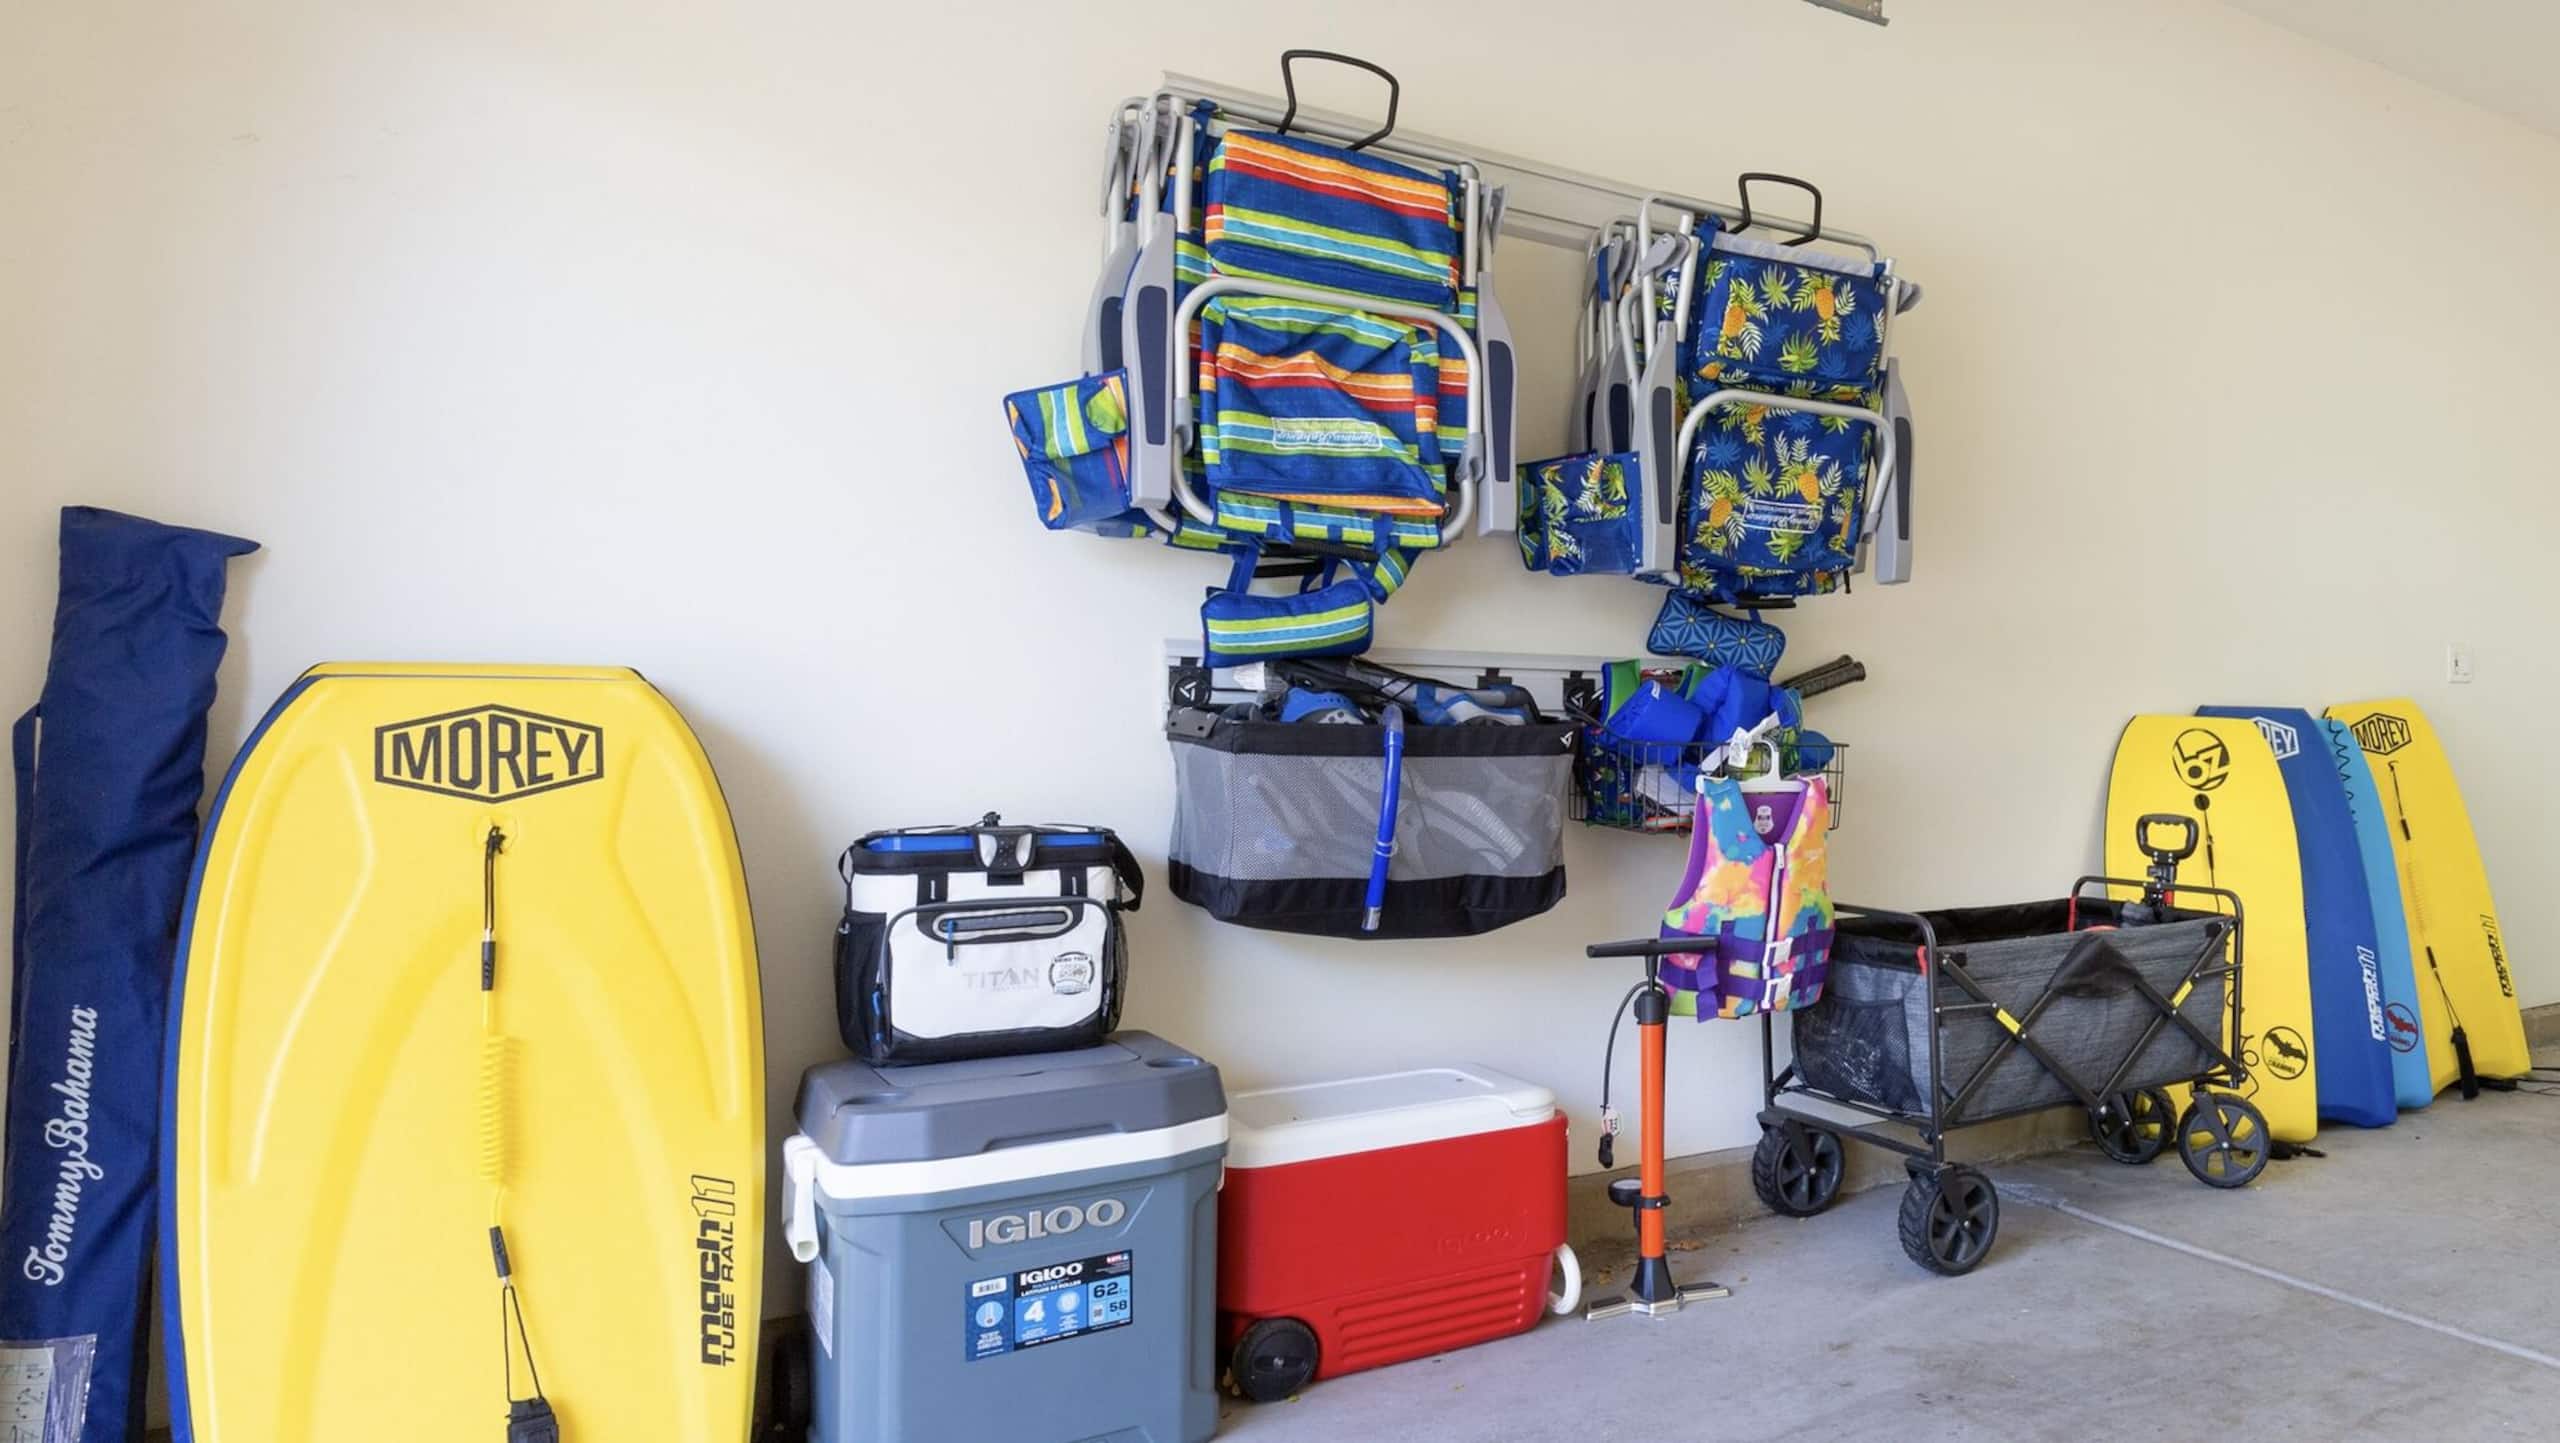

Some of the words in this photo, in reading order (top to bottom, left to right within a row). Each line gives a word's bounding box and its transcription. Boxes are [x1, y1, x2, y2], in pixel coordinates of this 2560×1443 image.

[2258, 721, 2294, 755] REY
[2355, 717, 2408, 752] MOREY
[392, 713, 590, 794] MOREY
[962, 967, 1040, 989] TITAN
[969, 1199, 1125, 1249] IGLOO
[721, 1221, 735, 1282] RAIL
[1020, 1262, 1084, 1287] IGLOO
[1093, 1281, 1119, 1299] 62
[1023, 1299, 1045, 1322] 4
[1109, 1300, 1128, 1312] 58
[721, 1292, 735, 1366] TUBE
